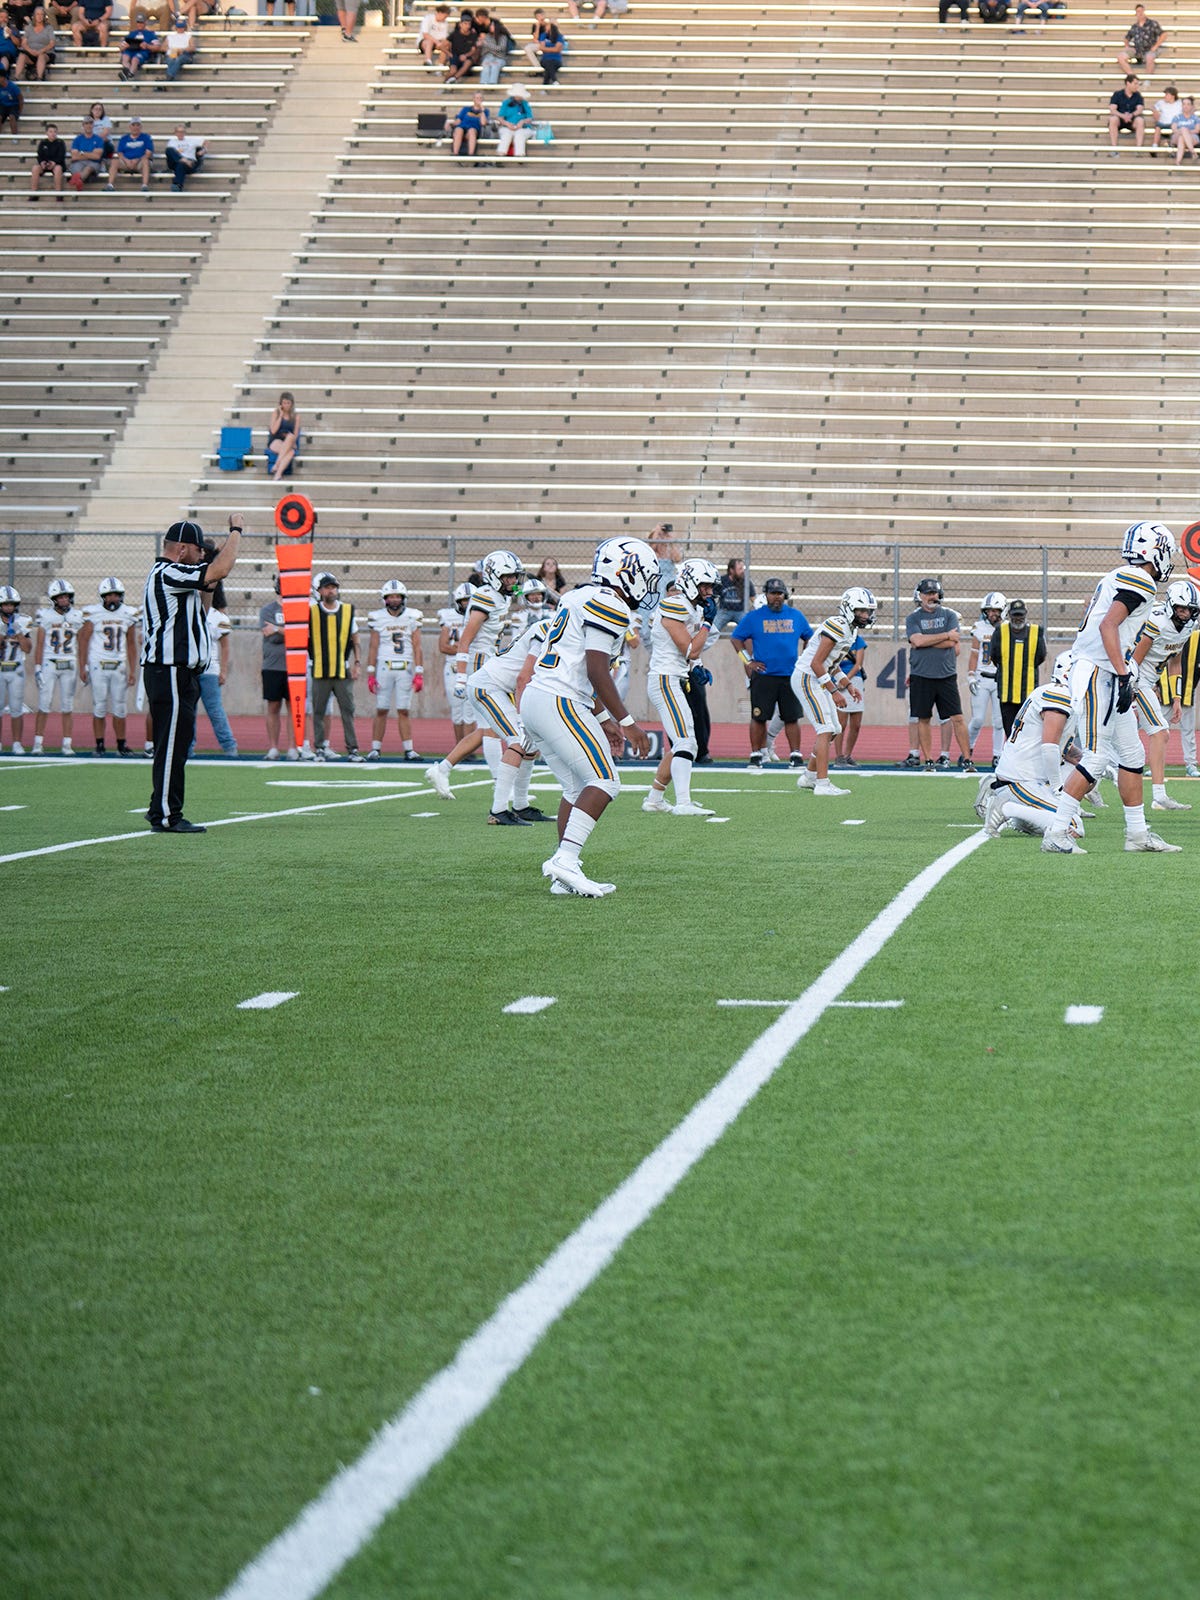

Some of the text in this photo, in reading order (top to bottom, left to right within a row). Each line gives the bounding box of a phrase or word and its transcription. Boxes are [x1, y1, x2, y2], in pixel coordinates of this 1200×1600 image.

[51, 629, 73, 654] 42
[103, 627, 121, 652] 31
[392, 632, 404, 654] 5
[876, 647, 907, 699] 4
